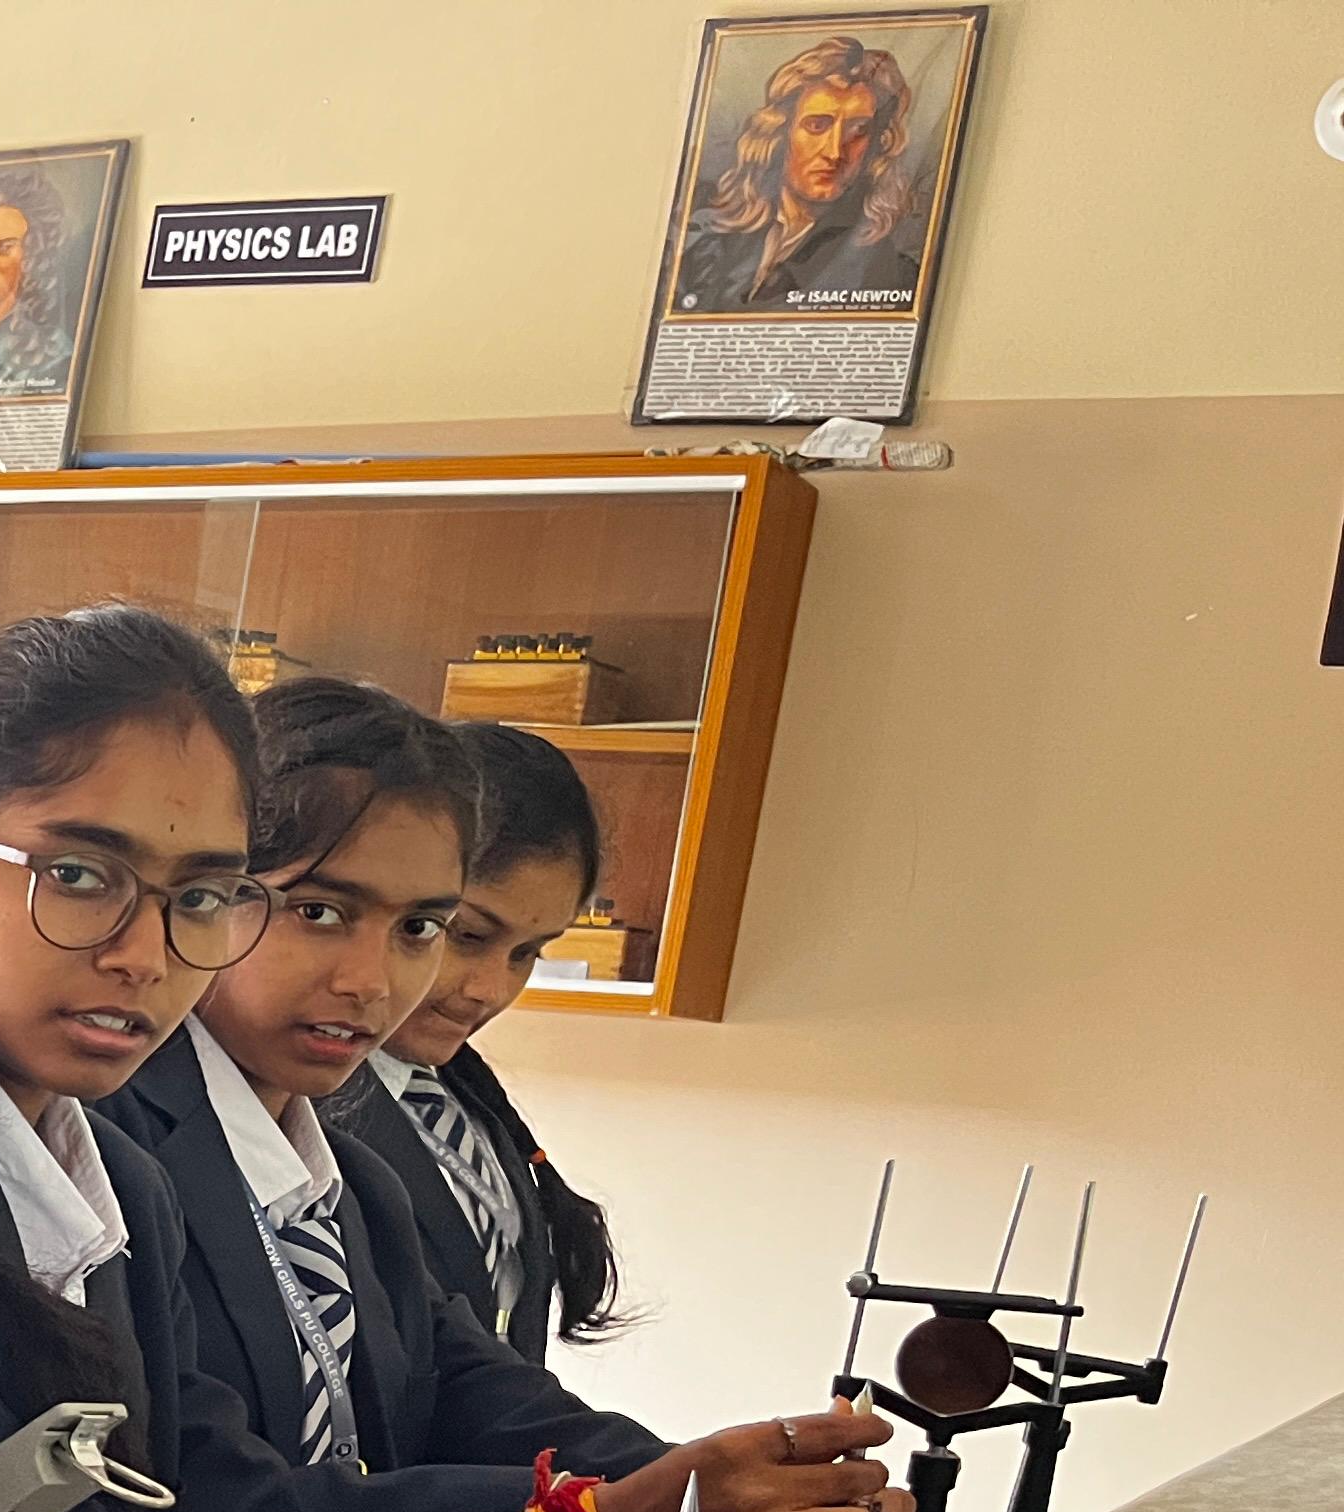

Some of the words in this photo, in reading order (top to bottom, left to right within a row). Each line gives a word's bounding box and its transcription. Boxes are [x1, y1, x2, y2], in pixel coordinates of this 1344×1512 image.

[163, 226, 292, 263] PHYSICS
[297, 223, 360, 259] LAB
[786, 290, 806, 303] Sir
[808, 290, 848, 303] ISAAC
[850, 289, 913, 303] NEWTON
[276, 1268, 305, 1311] GIRLS
[298, 1311, 318, 1332] PU
[311, 1332, 345, 1400] COLLEGE
